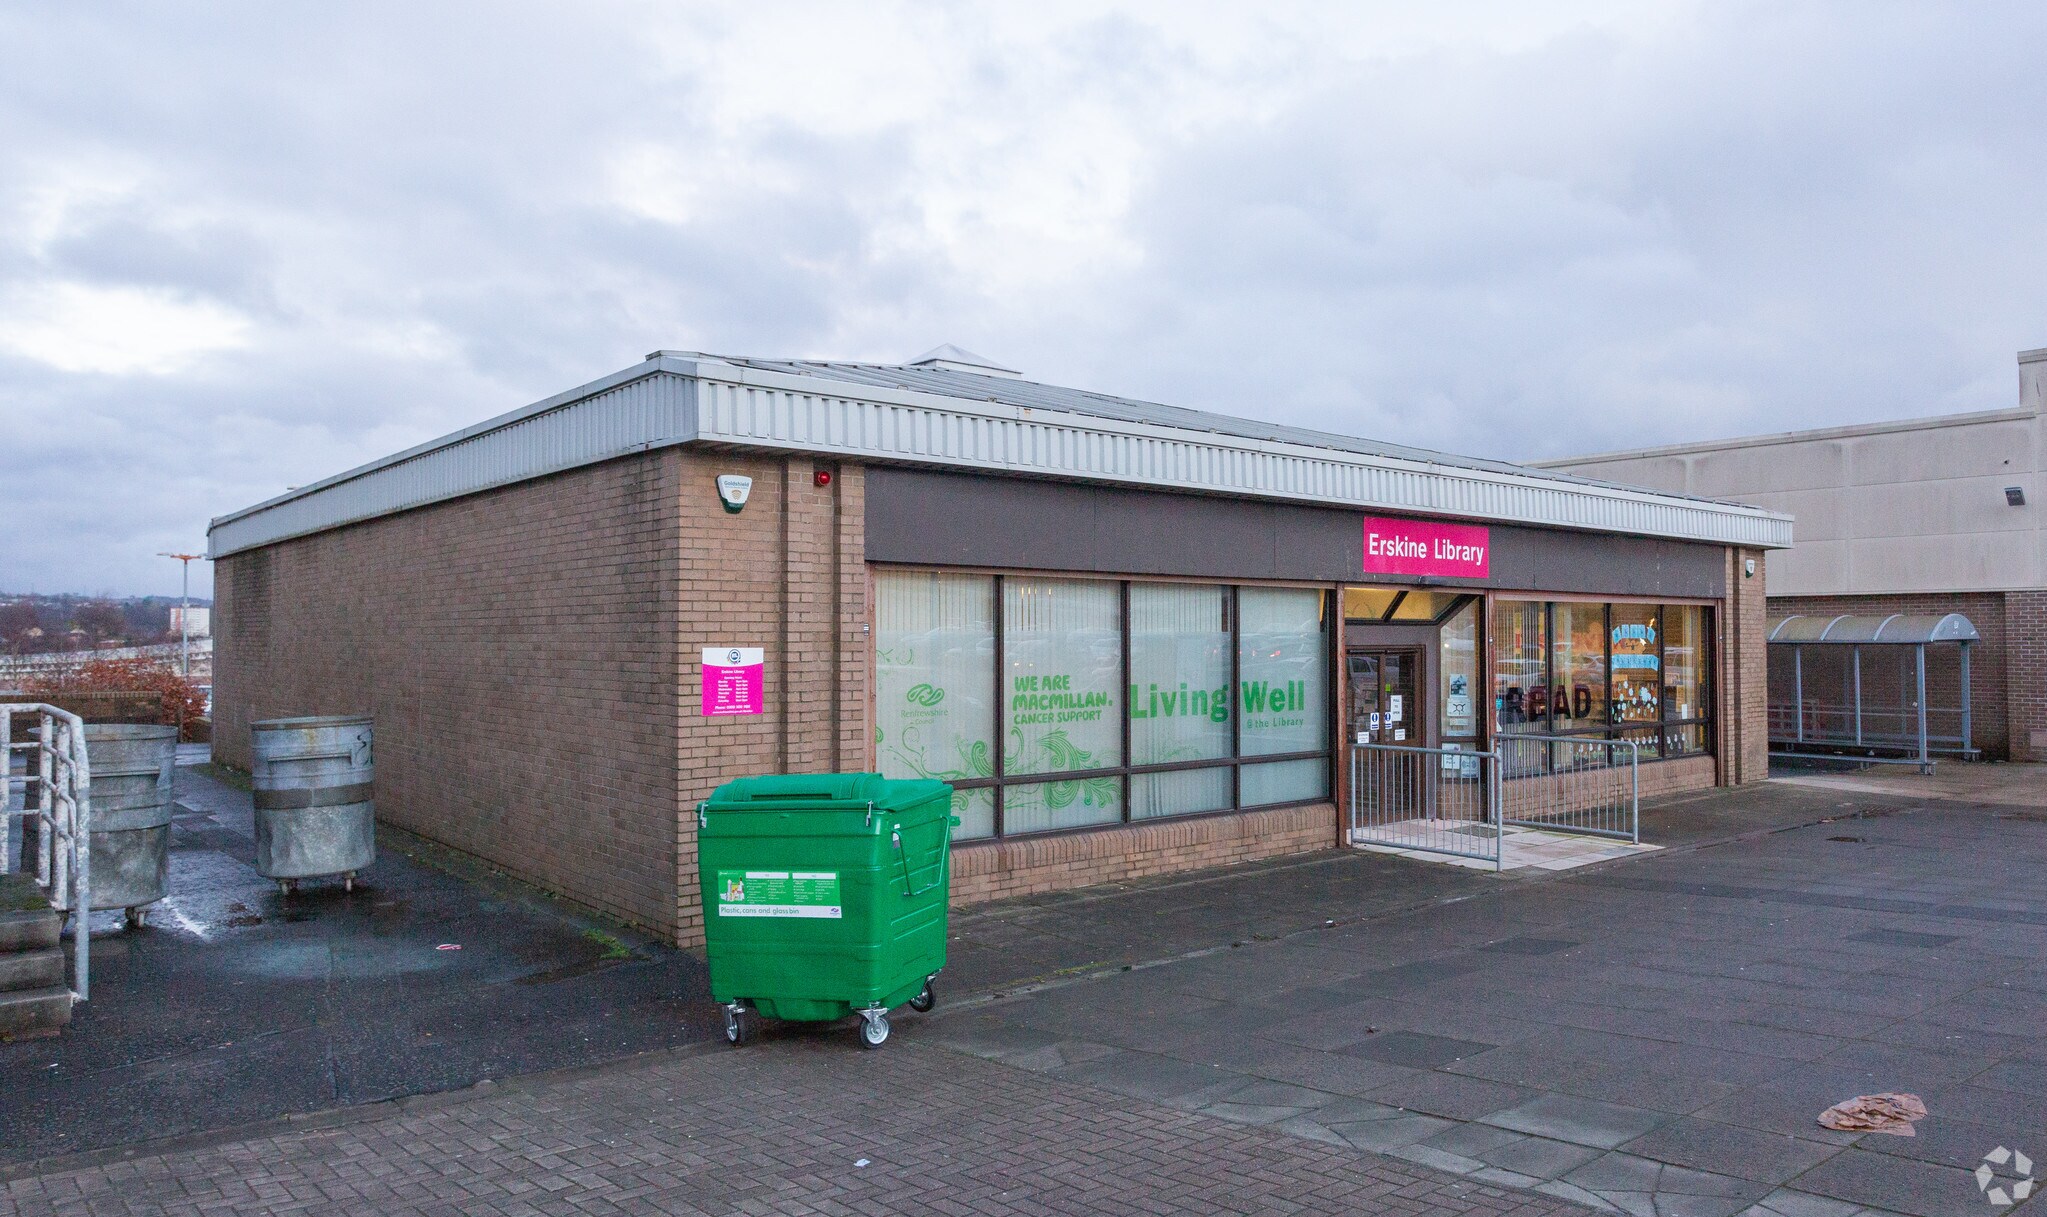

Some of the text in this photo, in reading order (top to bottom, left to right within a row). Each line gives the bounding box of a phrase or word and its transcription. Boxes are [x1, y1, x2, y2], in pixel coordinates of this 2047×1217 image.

[1369, 533, 1484, 566] Erskine Library
[1014, 674, 1070, 692] WE ARE
[1012, 691, 1113, 711] MACMILLAN.
[1130, 680, 1304, 723] Living Well
[900, 708, 949, 718] Renfrewshire
[1013, 709, 1103, 725] CANCER SUPPORT
[1255, 719, 1269, 728] the
[1272, 717, 1304, 729] Library
[720, 906, 742, 915] Plastic,
